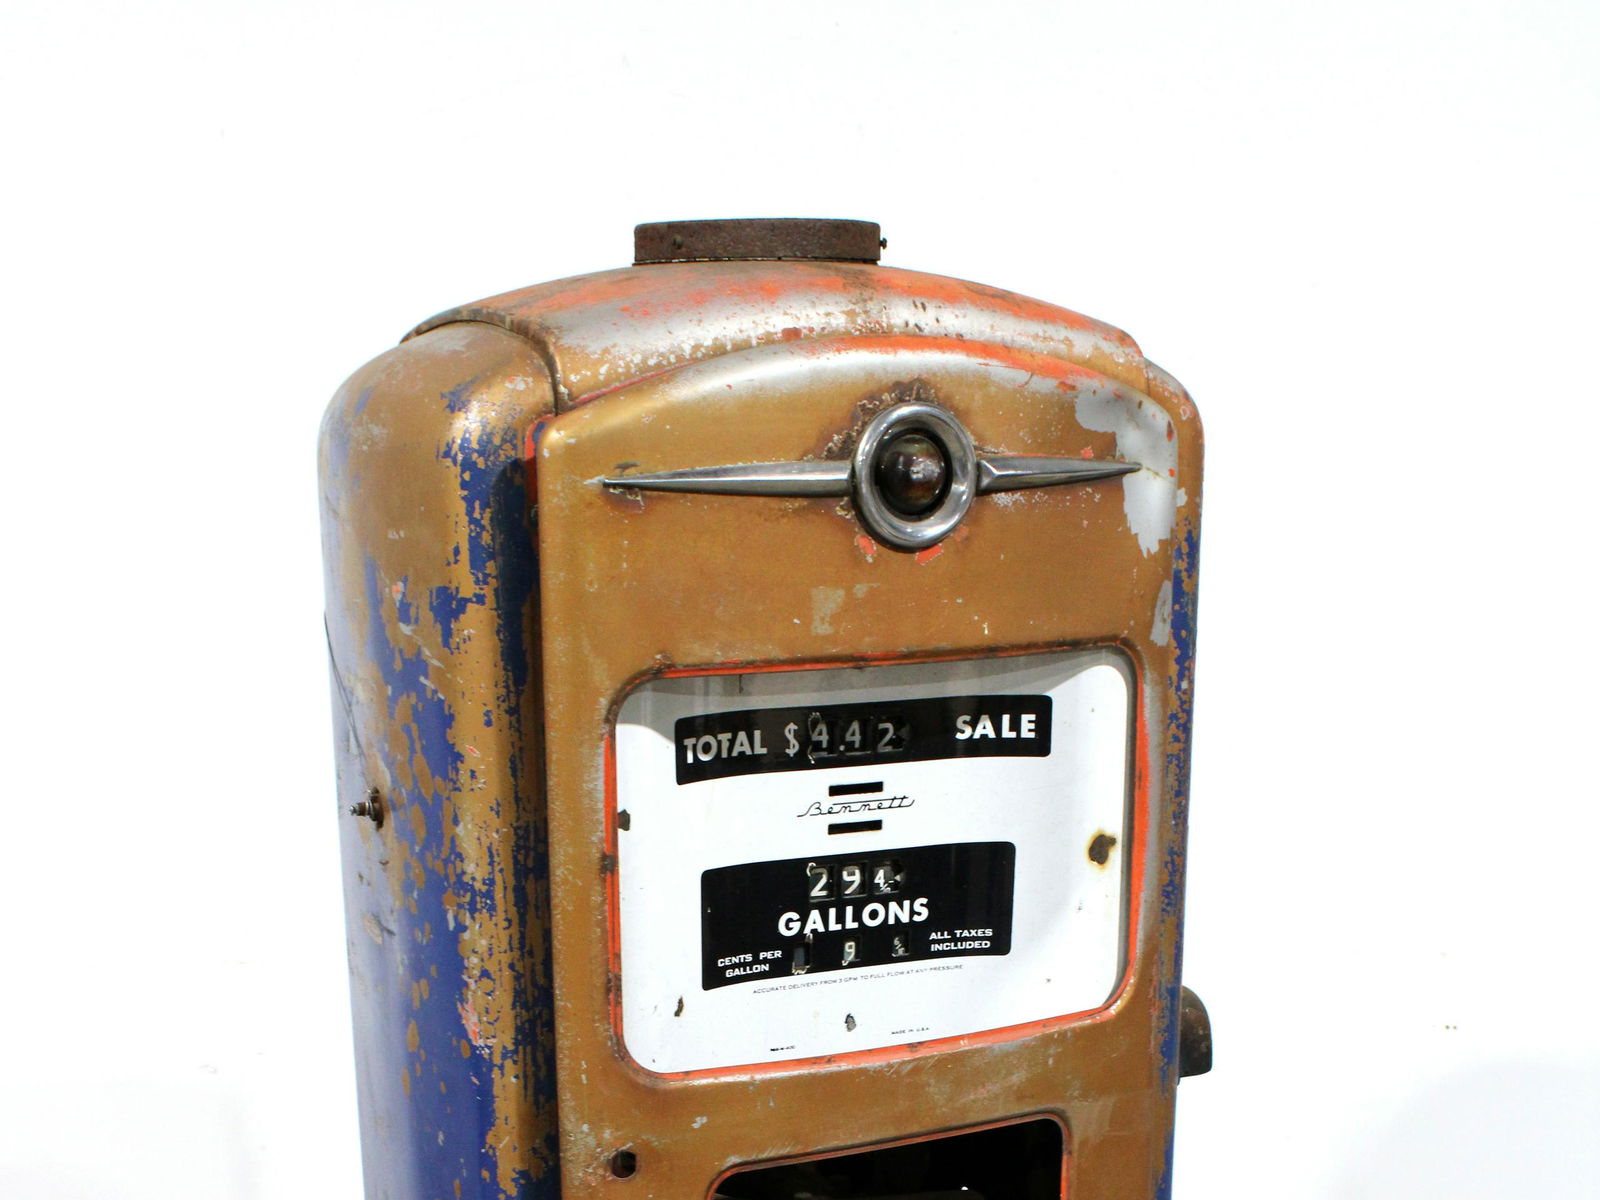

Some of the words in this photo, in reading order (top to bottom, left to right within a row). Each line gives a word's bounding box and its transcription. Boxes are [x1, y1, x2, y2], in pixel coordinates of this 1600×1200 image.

[684, 730, 767, 763] TOTAL
[955, 714, 1036, 740] SALE
[797, 795, 915, 818] Bennett
[778, 897, 929, 937] GALLONS
[929, 932, 951, 940] ALL
[954, 928, 993, 938] TAXES
[931, 940, 991, 952] INCLUDED
[717, 954, 753, 968] CENTS
[759, 950, 782, 961] PER
[725, 963, 769, 978] GALLON
